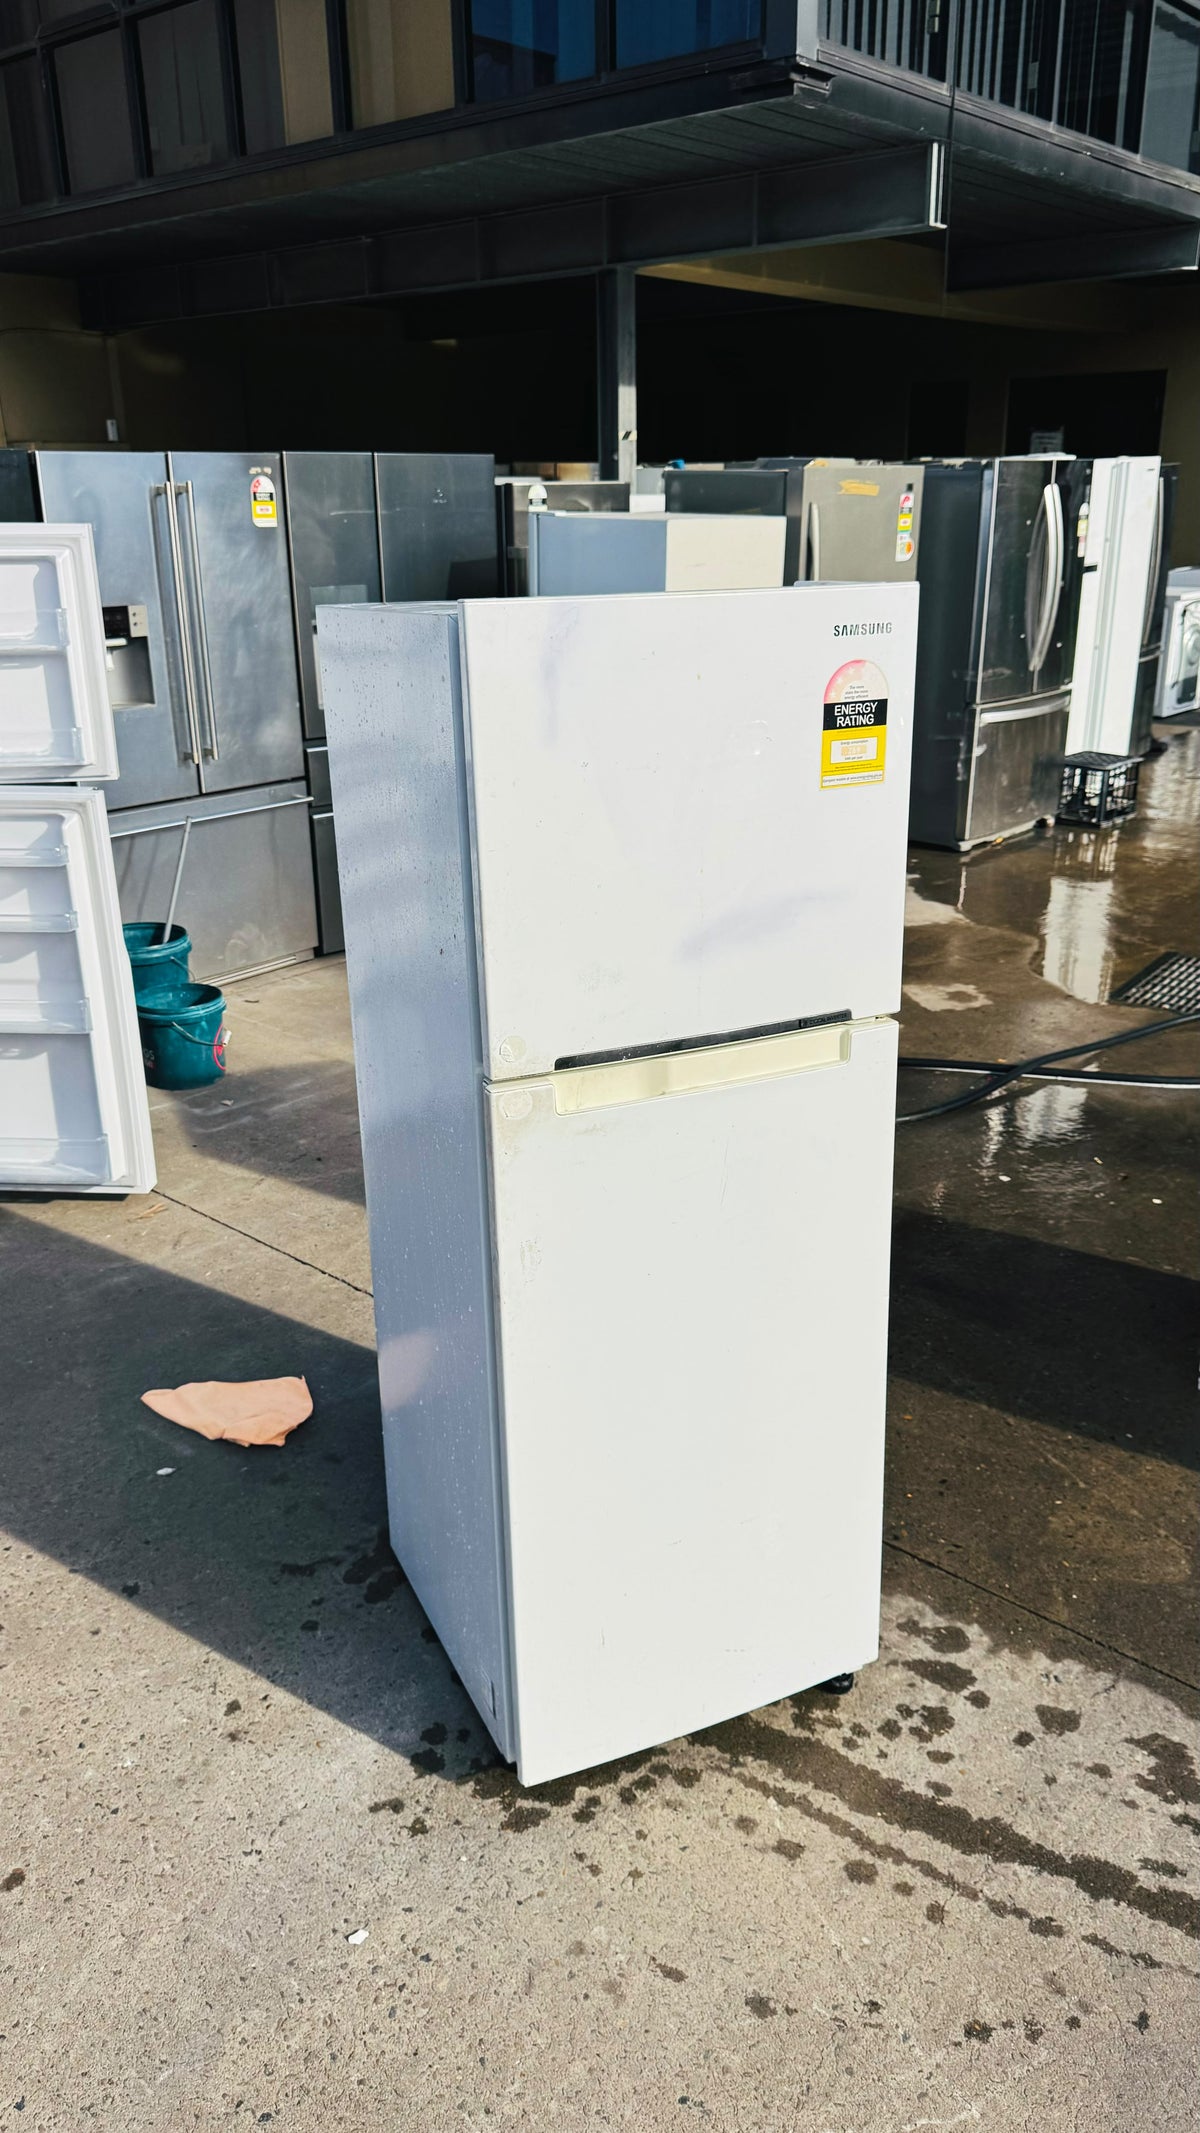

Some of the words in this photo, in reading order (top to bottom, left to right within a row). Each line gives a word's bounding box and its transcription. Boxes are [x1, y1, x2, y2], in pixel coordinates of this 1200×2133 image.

[833, 622, 892, 637] SAMSUNG
[834, 701, 878, 716] ENERGY
[836, 713, 875, 728] RATING
